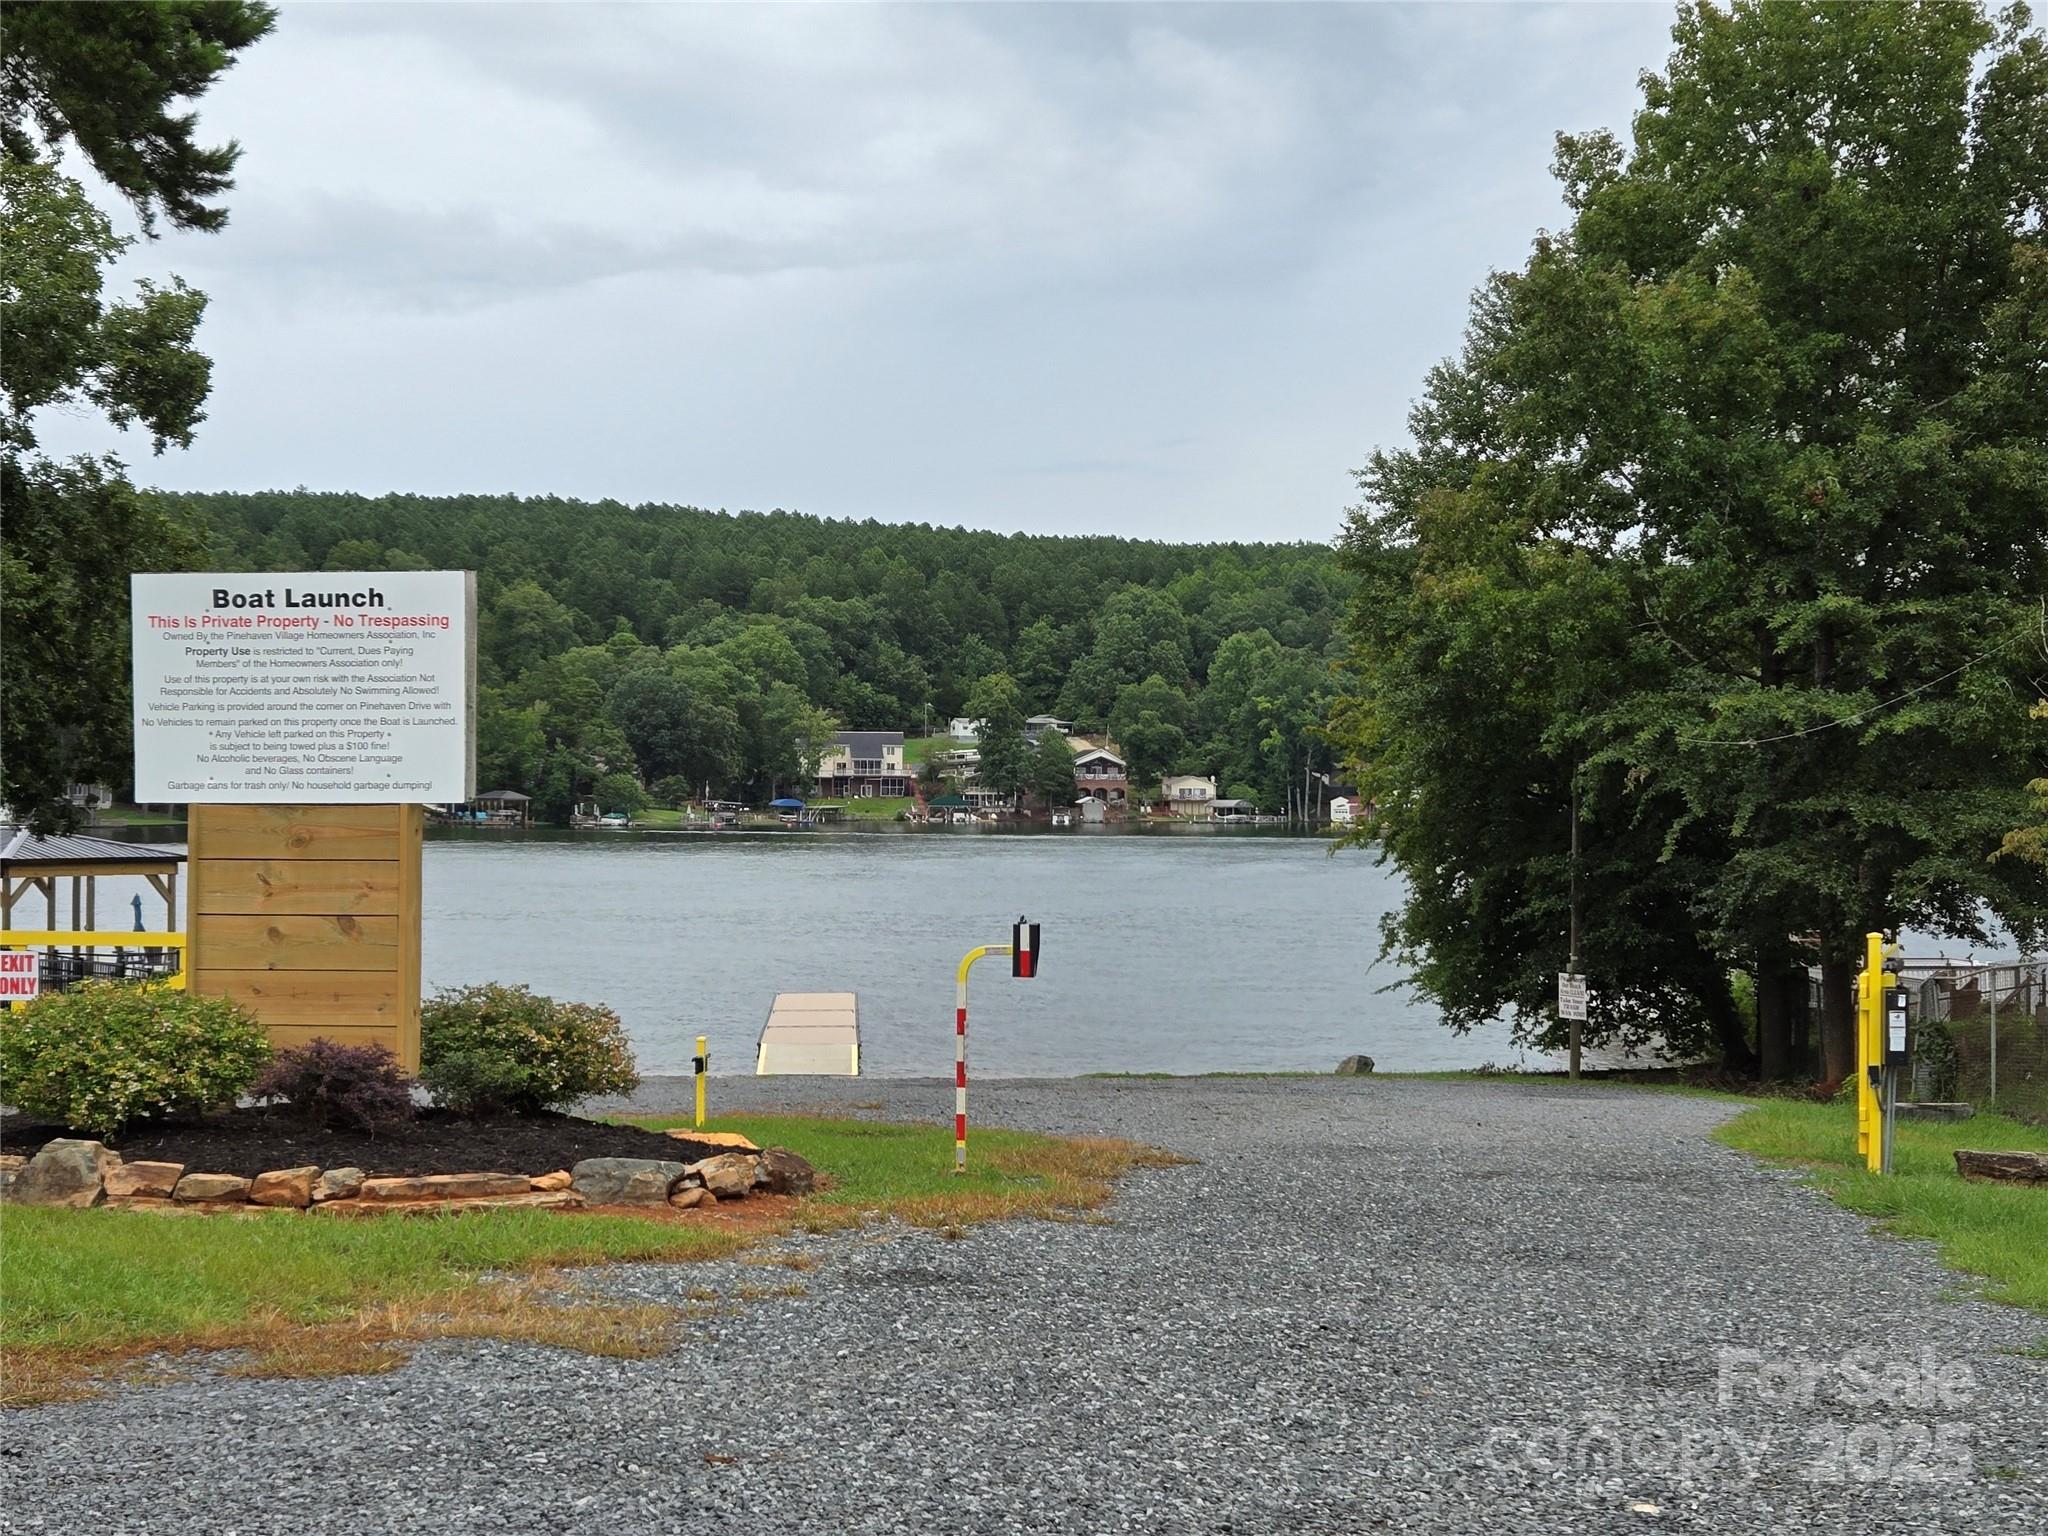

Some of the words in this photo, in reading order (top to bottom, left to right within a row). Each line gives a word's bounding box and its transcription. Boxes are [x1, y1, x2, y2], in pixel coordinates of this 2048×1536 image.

[212, 589, 275, 608] Boat
[285, 588, 384, 607] Launch
[148, 616, 180, 628] This
[185, 616, 197, 628] Is
[202, 615, 252, 627] Private
[257, 615, 319, 630] Property
[334, 614, 354, 627] No
[358, 614, 449, 629] Trespassing
[163, 631, 194, 640] Owned
[196, 631, 208, 642] By
[210, 632, 224, 640] the
[226, 631, 273, 640] Pinehaven
[275, 631, 304, 642] Village
[306, 631, 365, 639] Homeowners
[366, 631, 419, 641] Association,
[422, 631, 436, 639] Inc
[185, 646, 229, 658] Property
[231, 646, 251, 656] Use
[253, 648, 261, 656] is
[263, 647, 303, 655] restricted
[316, 646, 355, 655] "Current,
[358, 646, 382, 655] Dues
[384, 646, 414, 656] Paying
[196, 659, 240, 668] Members"
[242, 659, 251, 668] of
[269, 659, 327, 667] Homeowners
[328, 659, 379, 667] Association
[381, 658, 403, 668] only!
[164, 675, 182, 684] Use
[183, 675, 192, 683] of
[194, 675, 210, 683] this
[212, 676, 249, 685] property
[250, 675, 258, 683] is
[260, 675, 269, 683] at
[271, 676, 291, 685] your
[313, 675, 329, 683] risk
[331, 675, 349, 683] with
[351, 675, 365, 683] the
[366, 674, 417, 683] Association
[419, 674, 435, 682] Not
[160, 687, 213, 697] Responsible
[215, 687, 227, 695] for
[229, 687, 272, 695] Accidents
[274, 687, 291, 695] and
[292, 686, 338, 696] Absolutely
[340, 686, 353, 695] No
[355, 686, 400, 696] Swimming
[402, 686, 439, 694] Allowed!
[148, 703, 179, 711] Vehicle
[182, 702, 215, 713] Parking
[227, 702, 265, 712] provided
[266, 702, 297, 711] around
[360, 702, 406, 710] Pinehaven
[408, 702, 431, 710] Drive
[142, 718, 154, 726] No
[156, 718, 193, 726] Vehicles
[238, 718, 268, 728] parked
[283, 718, 300, 726] this
[301, 718, 338, 727] property
[363, 718, 378, 726] the
[380, 717, 401, 726] Boat
[412, 717, 457, 726] Launched.
[215, 730, 232, 740] Any
[234, 730, 266, 738] Vehicle
[268, 730, 281, 738] left
[283, 730, 314, 739] parked
[329, 730, 345, 738] this
[347, 730, 385, 740] Property
[219, 742, 250, 752] subject
[263, 742, 287, 752] being
[289, 742, 316, 750] towed
[318, 742, 336, 752] plus
[346, 742, 369, 750] $100
[370, 742, 390, 750] fine!
[197, 754, 209, 763] No
[211, 754, 250, 763] Alcoholic
[252, 755, 300, 764] beverages,
[303, 754, 316, 762] No
[317, 754, 357, 763] Obscene
[359, 754, 403, 764] Language
[245, 766, 262, 775] and
[264, 766, 277, 775] No
[279, 766, 304, 775] Glass
[306, 766, 354, 775] containers!
[168, 781, 205, 791] Garbage
[230, 781, 242, 789] for
[244, 781, 266, 790] trash
[292, 781, 304, 789] No
[306, 781, 351, 790] household
[353, 782, 390, 791] garbage
[392, 781, 432, 791] dumping!
[1, 954, 35, 972] EXIT
[0, 977, 37, 994] ONLY
